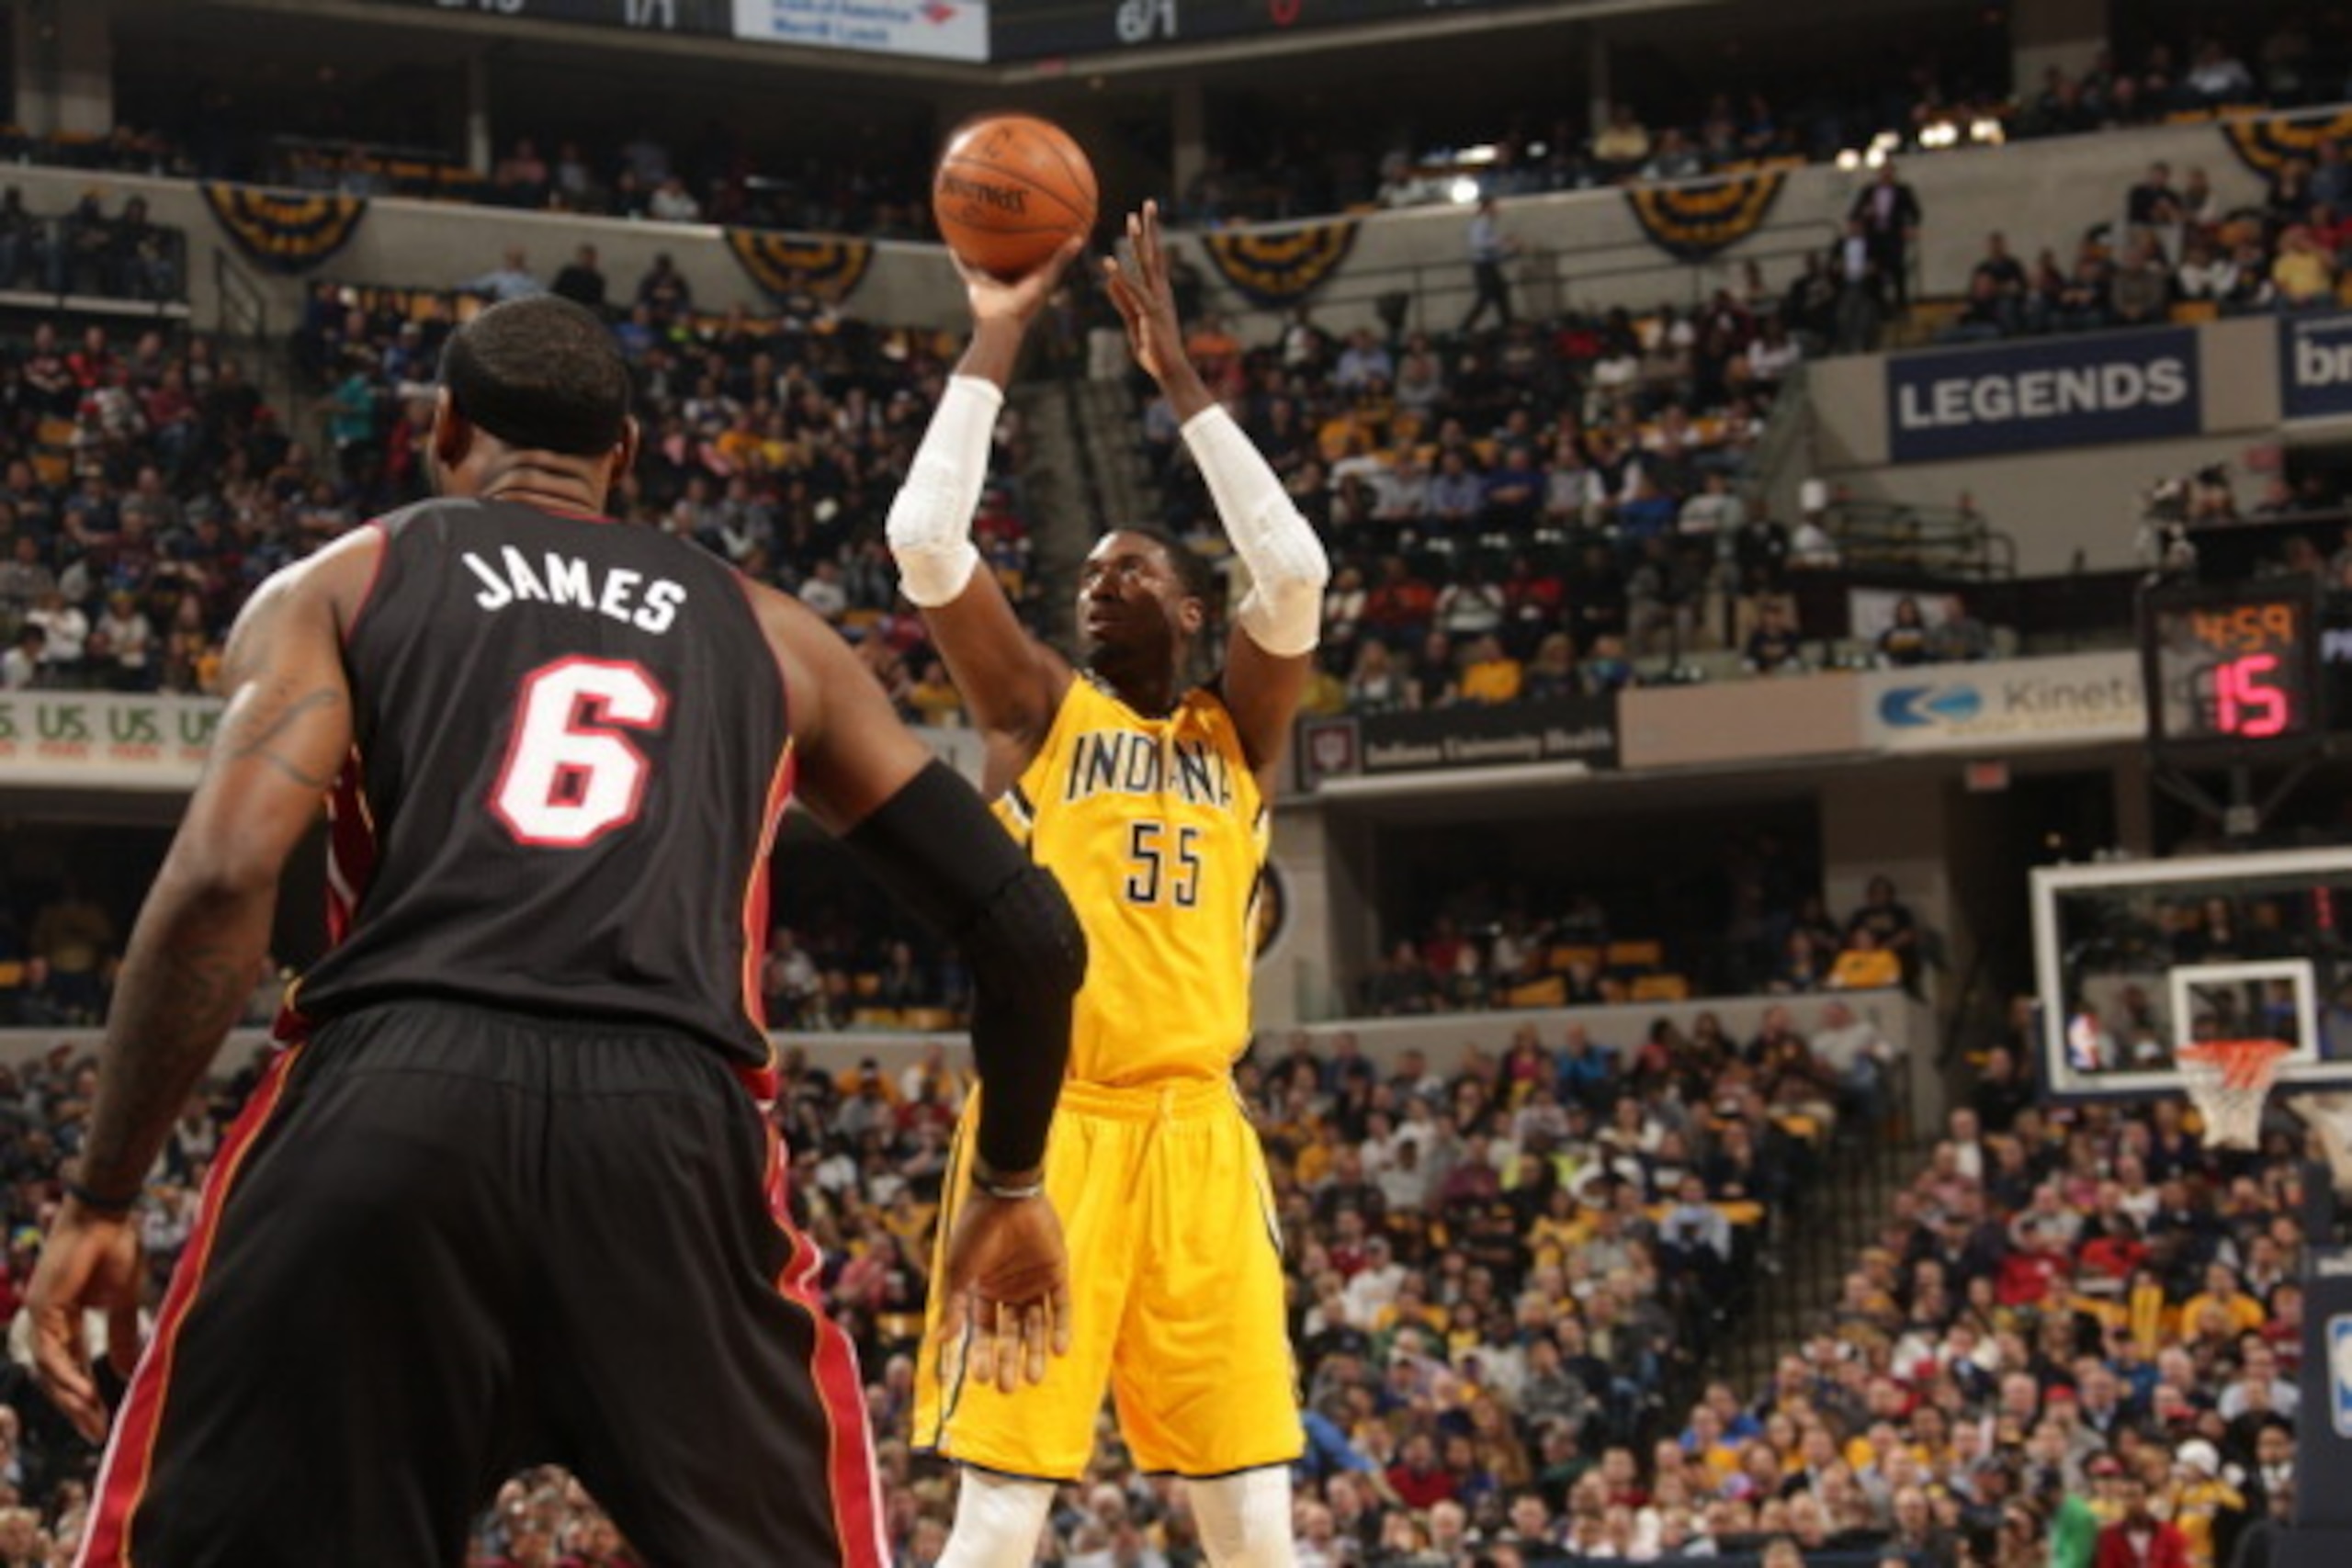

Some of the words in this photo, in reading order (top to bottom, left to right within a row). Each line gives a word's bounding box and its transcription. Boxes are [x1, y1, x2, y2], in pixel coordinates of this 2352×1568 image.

[1115, 0, 1179, 41] 6/1
[1898, 357, 2188, 429] LEGENDS
[462, 545, 687, 634] JAMES
[2214, 653, 2288, 738] 15
[483, 653, 671, 848] 6
[1066, 732, 1233, 807] INDIN
[1125, 819, 1200, 909] 55
